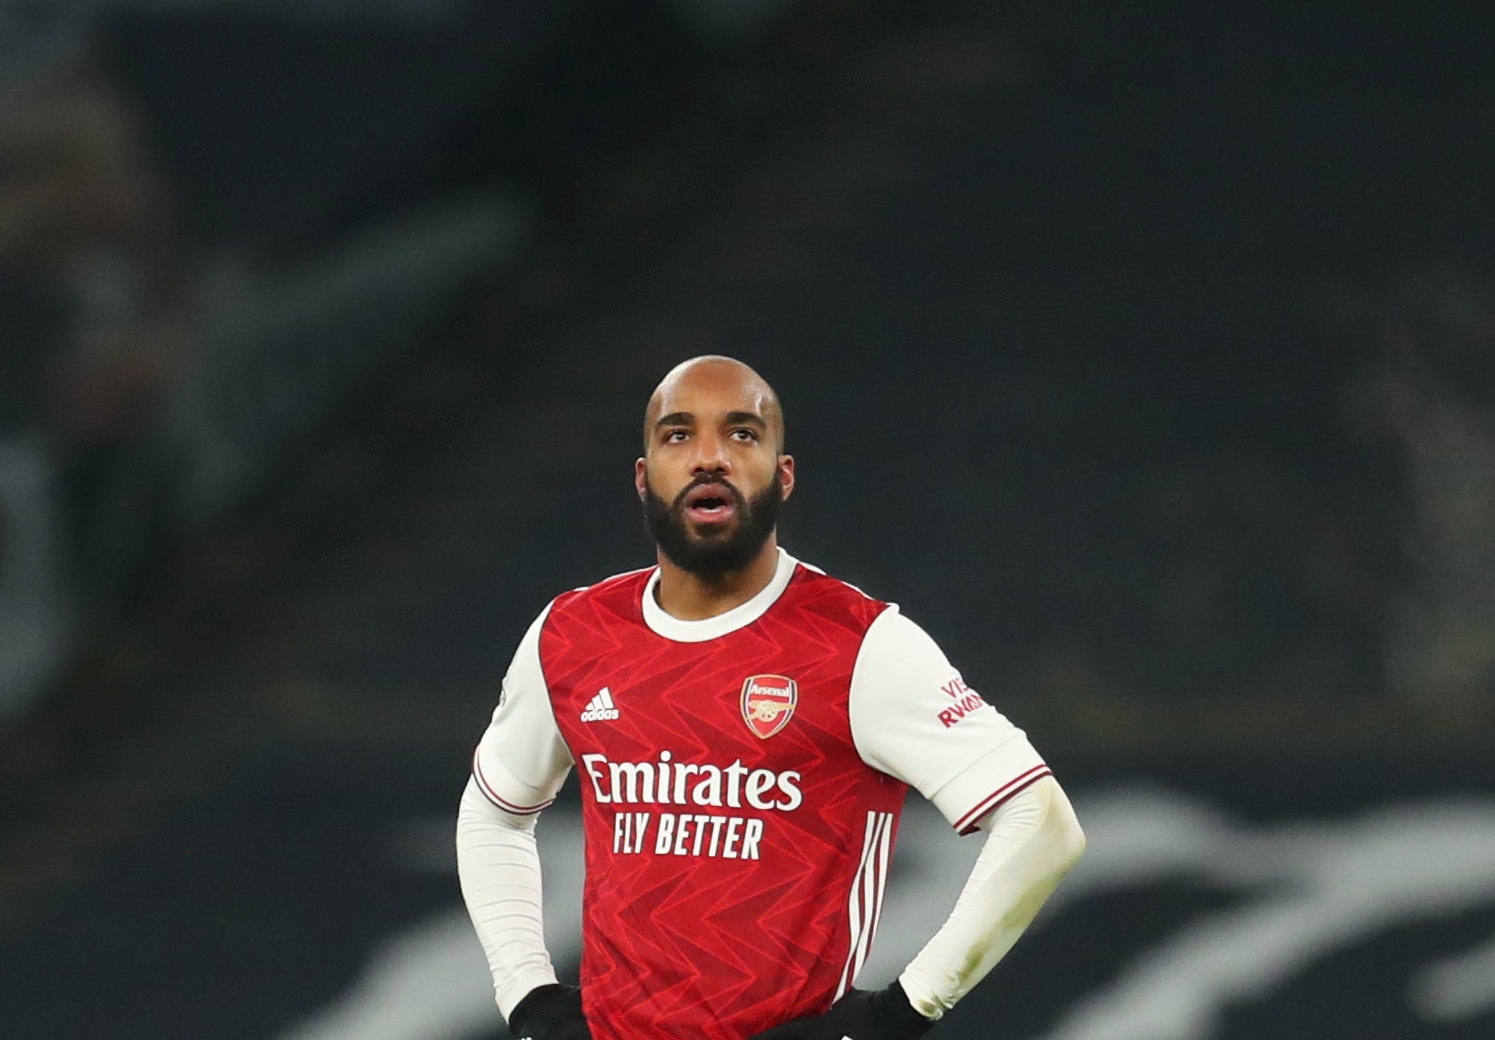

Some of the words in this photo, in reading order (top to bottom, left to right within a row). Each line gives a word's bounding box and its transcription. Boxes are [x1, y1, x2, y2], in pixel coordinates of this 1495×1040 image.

[750, 684, 790, 697] Arsenal
[581, 706, 619, 722] adidas
[581, 750, 802, 811] Emirates
[613, 812, 650, 854] FLY
[655, 813, 763, 860] BETTER
